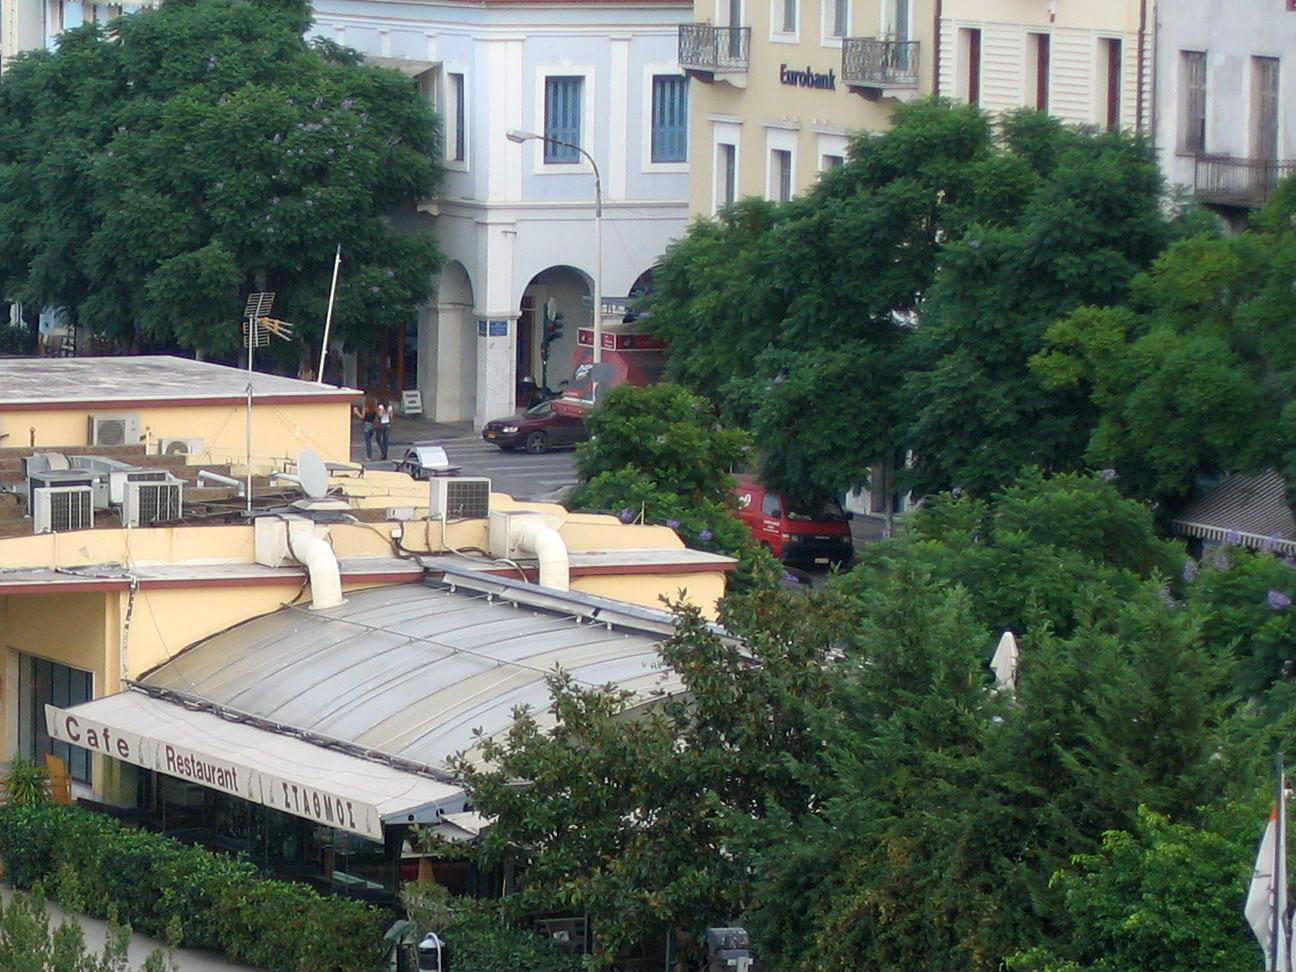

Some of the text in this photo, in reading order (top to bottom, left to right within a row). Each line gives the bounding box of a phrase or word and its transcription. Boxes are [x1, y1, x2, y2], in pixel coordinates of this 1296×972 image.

[780, 63, 836, 92] Eurobank
[65, 715, 357, 829] Cafe Restaurant ΣΤΑΘΜΟΣ
